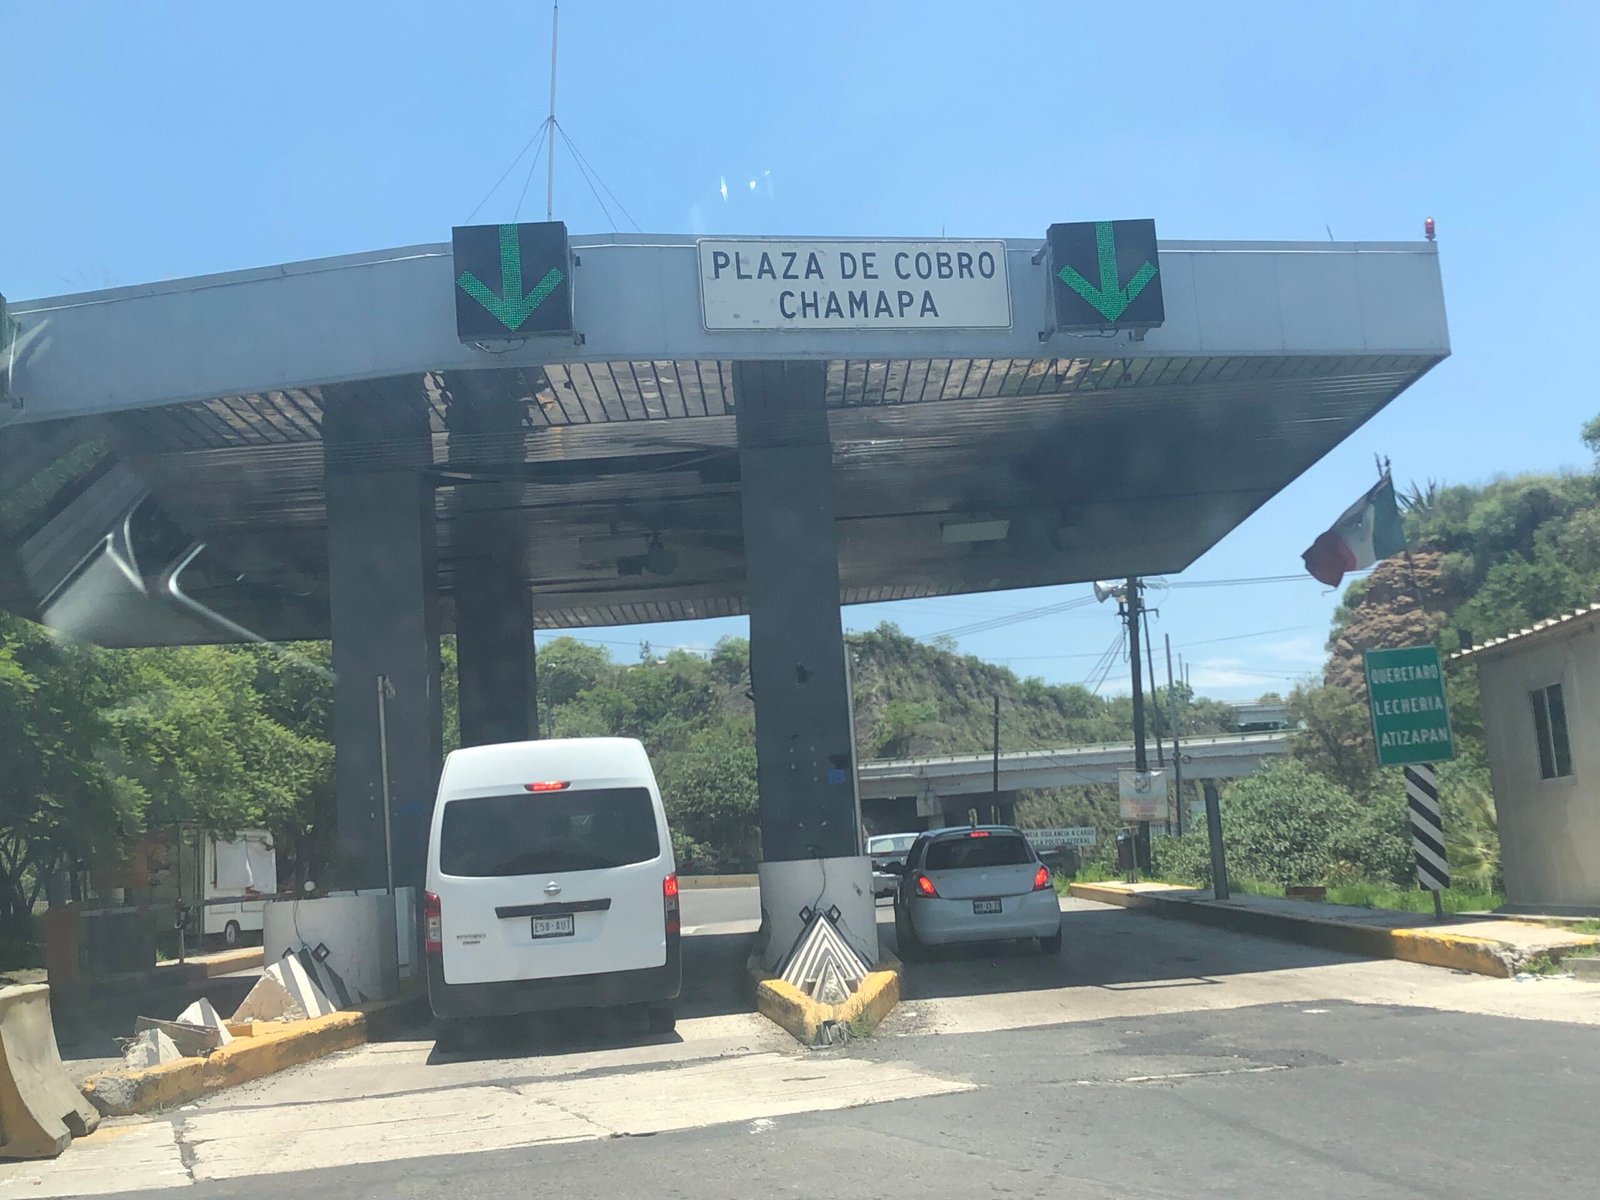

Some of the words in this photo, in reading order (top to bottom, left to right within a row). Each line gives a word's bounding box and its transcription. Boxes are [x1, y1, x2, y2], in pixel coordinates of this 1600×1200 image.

[712, 251, 825, 280] PLAZA
[839, 251, 879, 280] DE
[894, 251, 996, 280] COBRO
[779, 290, 940, 319] CHAMAPA
[1370, 664, 1439, 684] QUERETARO
[1375, 696, 1444, 716] LECHERIA
[1381, 727, 1449, 748] ATIZAPAN
